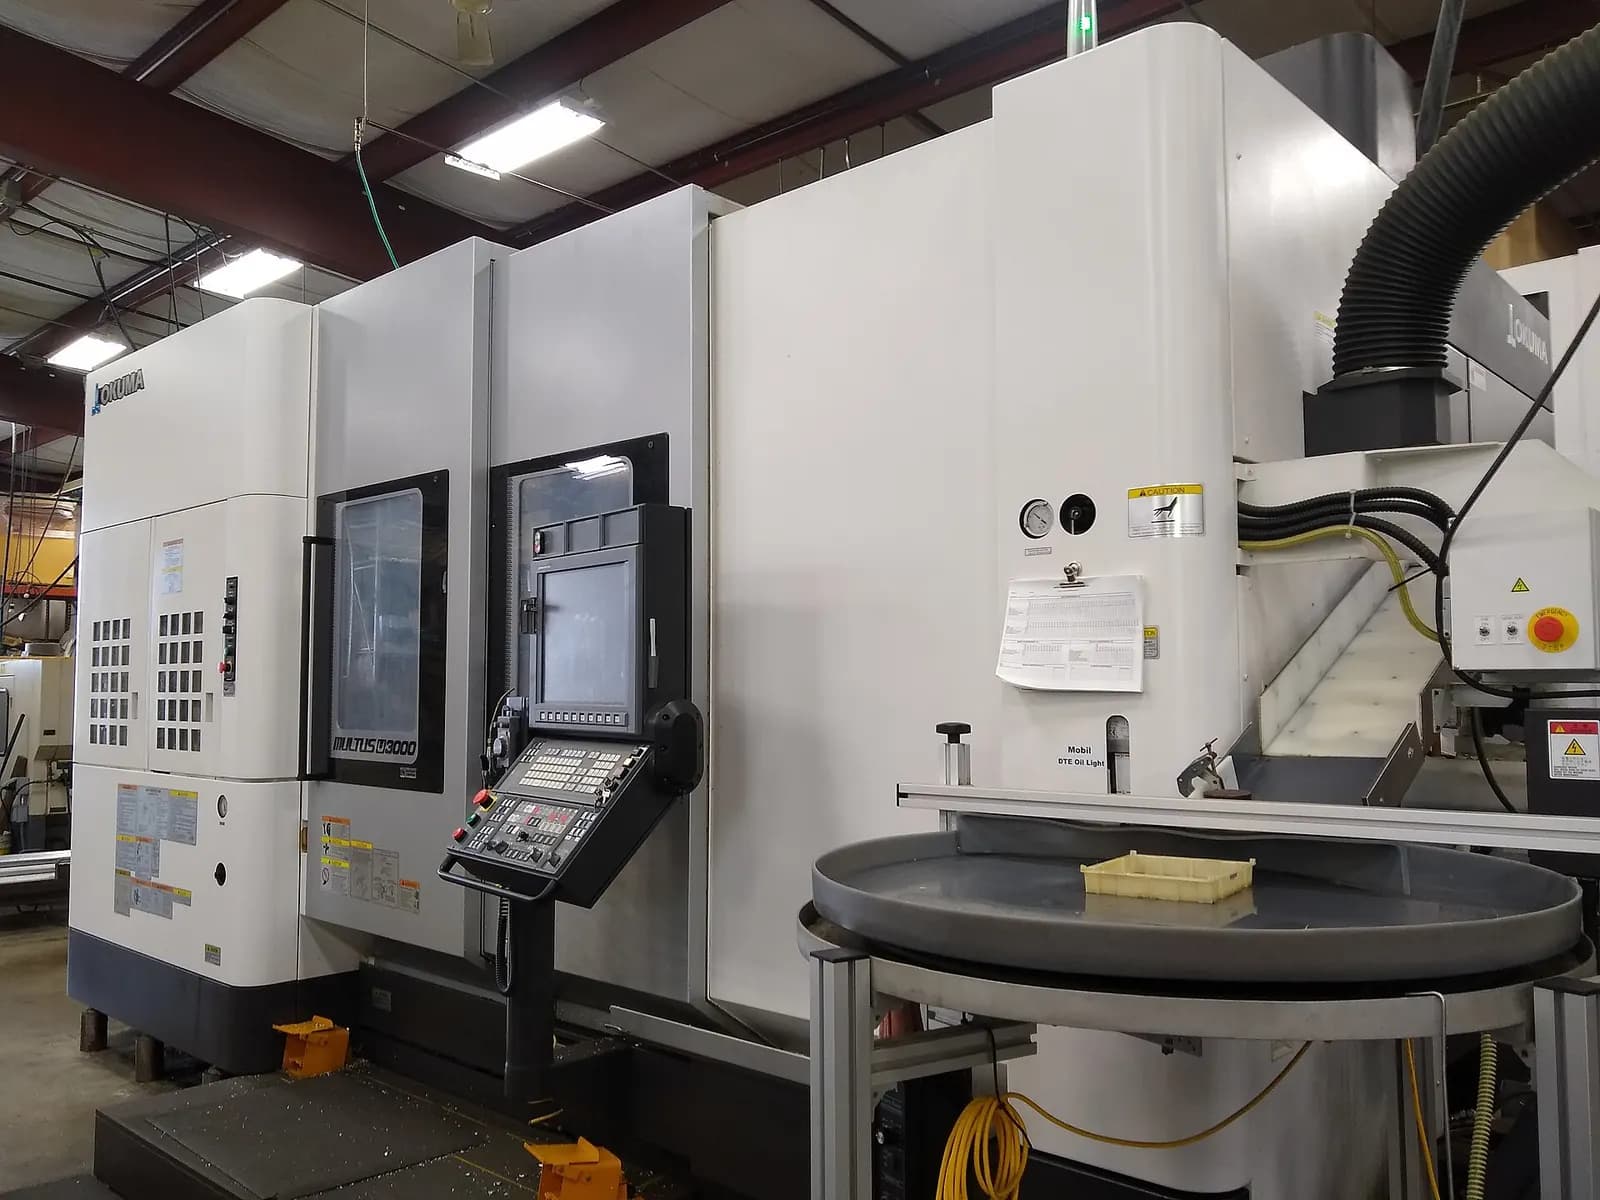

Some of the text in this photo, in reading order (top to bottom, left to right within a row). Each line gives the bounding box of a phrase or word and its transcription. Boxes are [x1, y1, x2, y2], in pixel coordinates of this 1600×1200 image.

[1515, 318, 1549, 365] OKUMA
[100, 368, 145, 406] OKUMA
[1147, 487, 1185, 497] CAUTION
[333, 736, 376, 752] MULTUS
[1067, 746, 1092, 754] Mobil
[1086, 760, 1105, 768] Light
